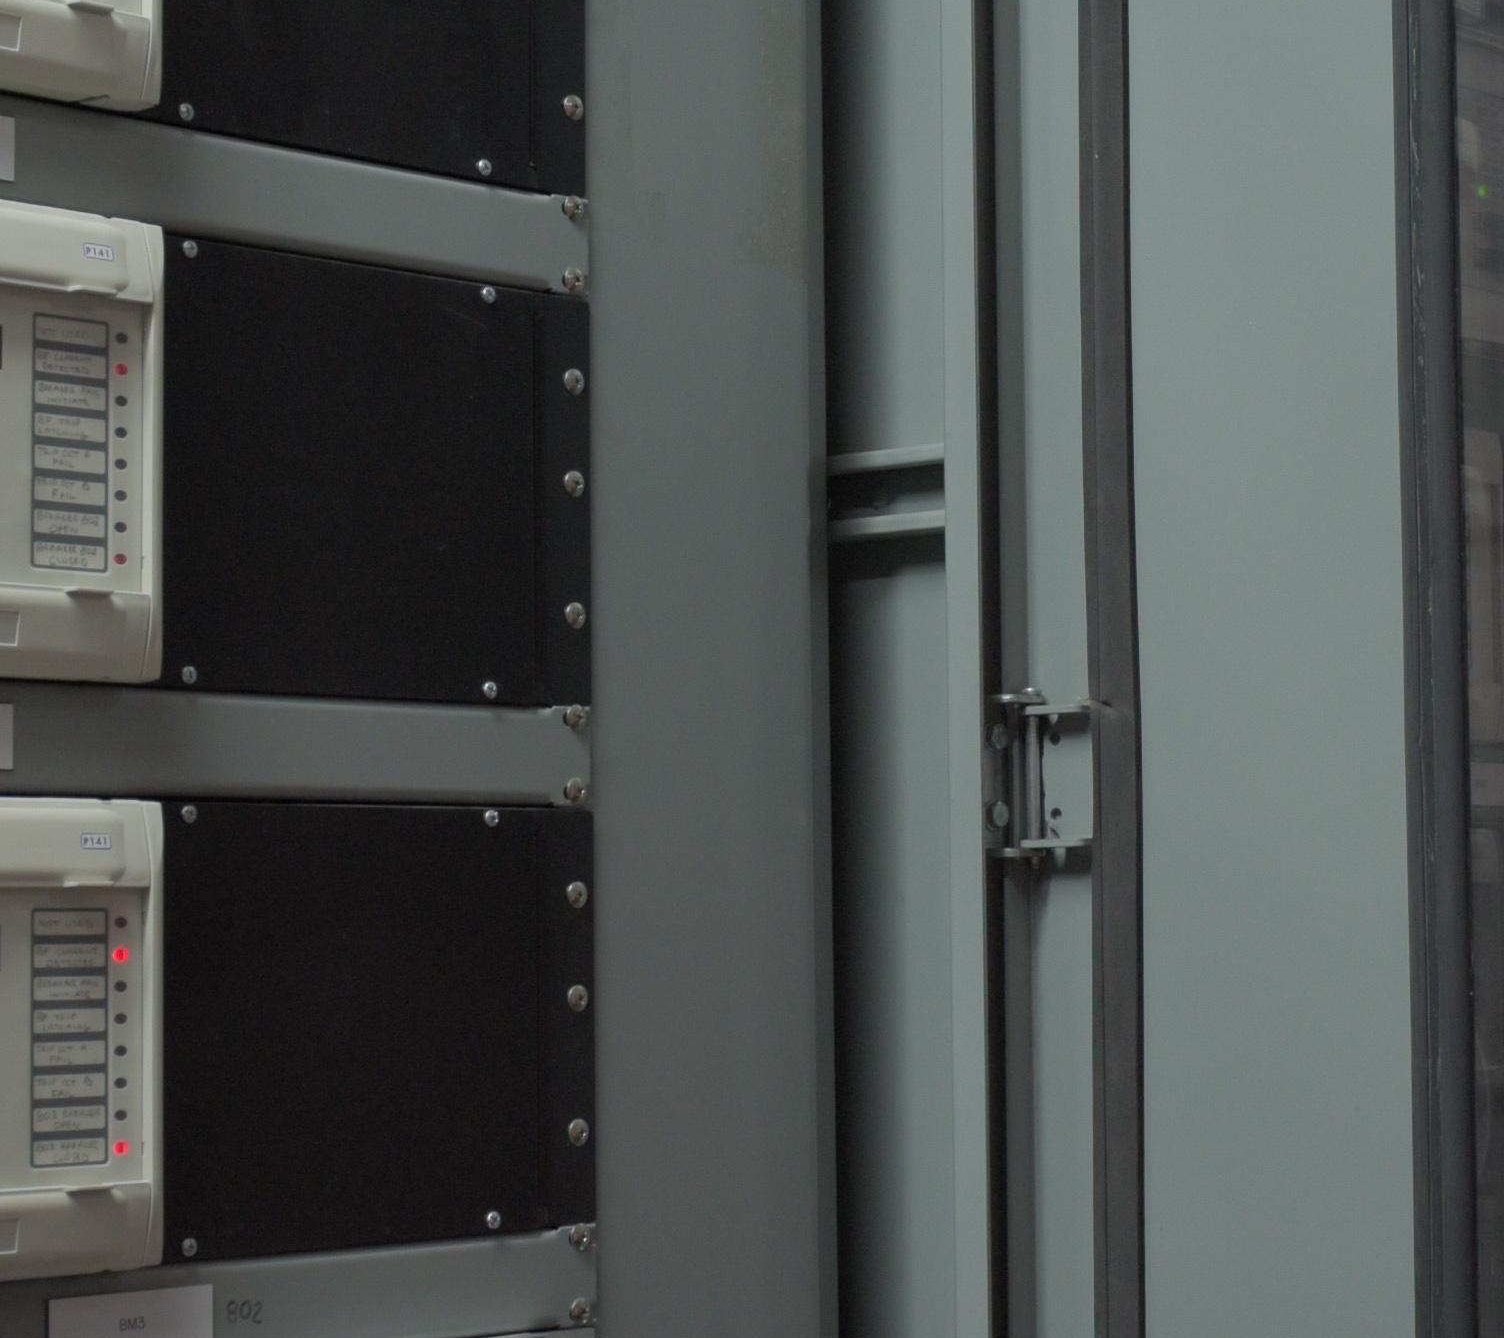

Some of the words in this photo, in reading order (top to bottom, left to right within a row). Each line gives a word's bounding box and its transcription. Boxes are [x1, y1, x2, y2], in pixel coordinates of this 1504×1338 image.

[84, 244, 111, 259] P141
[82, 835, 108, 848] P141
[225, 1300, 265, 1324] 802
[117, 1315, 148, 1333] BM3
